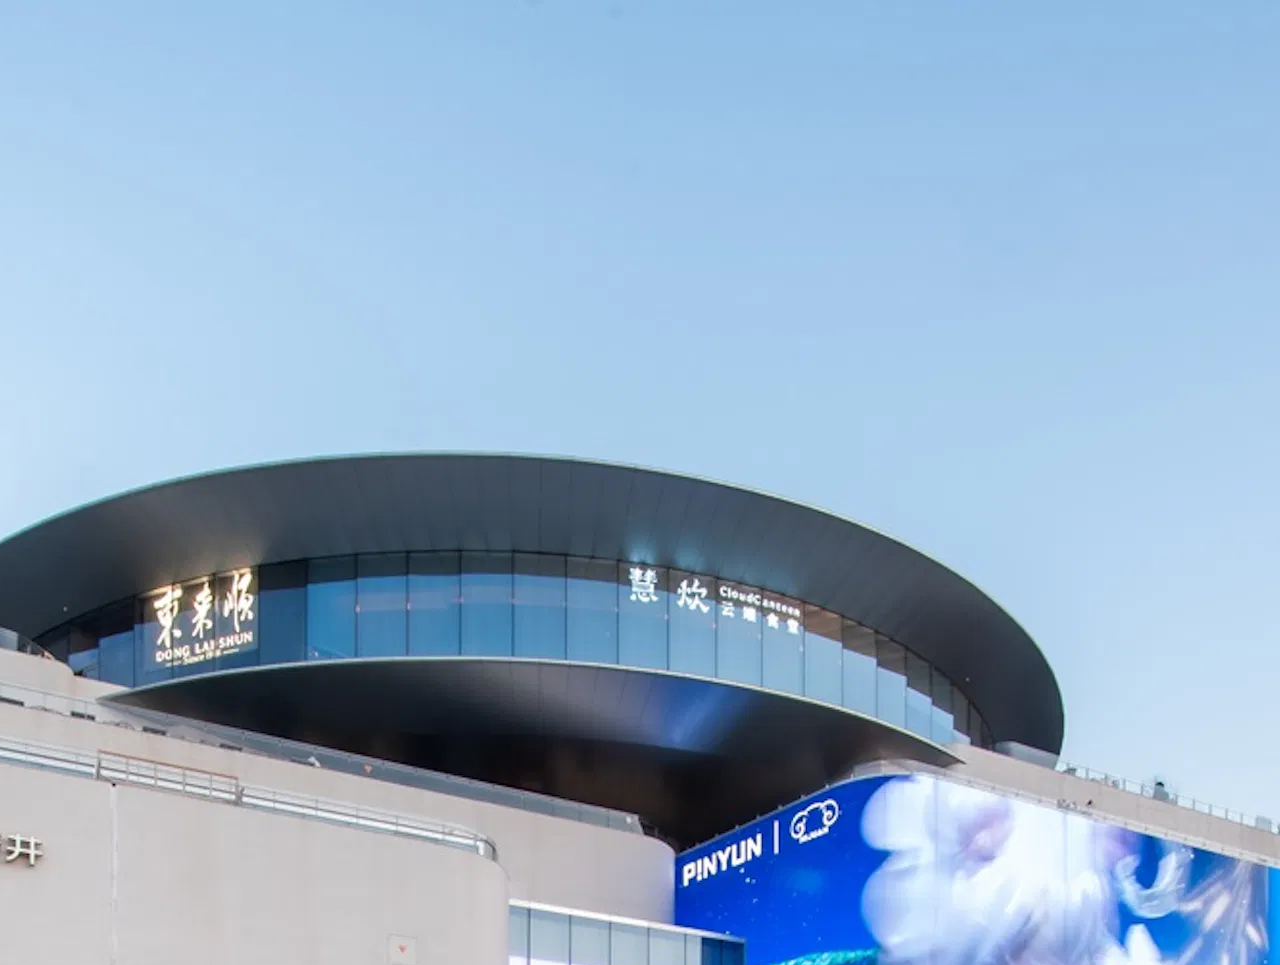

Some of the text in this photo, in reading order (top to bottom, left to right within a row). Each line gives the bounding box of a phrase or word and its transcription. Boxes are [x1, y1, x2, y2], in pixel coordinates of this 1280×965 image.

[155, 645, 190, 662] DONG
[195, 640, 215, 654] LAI
[219, 631, 253, 649] SHUN
